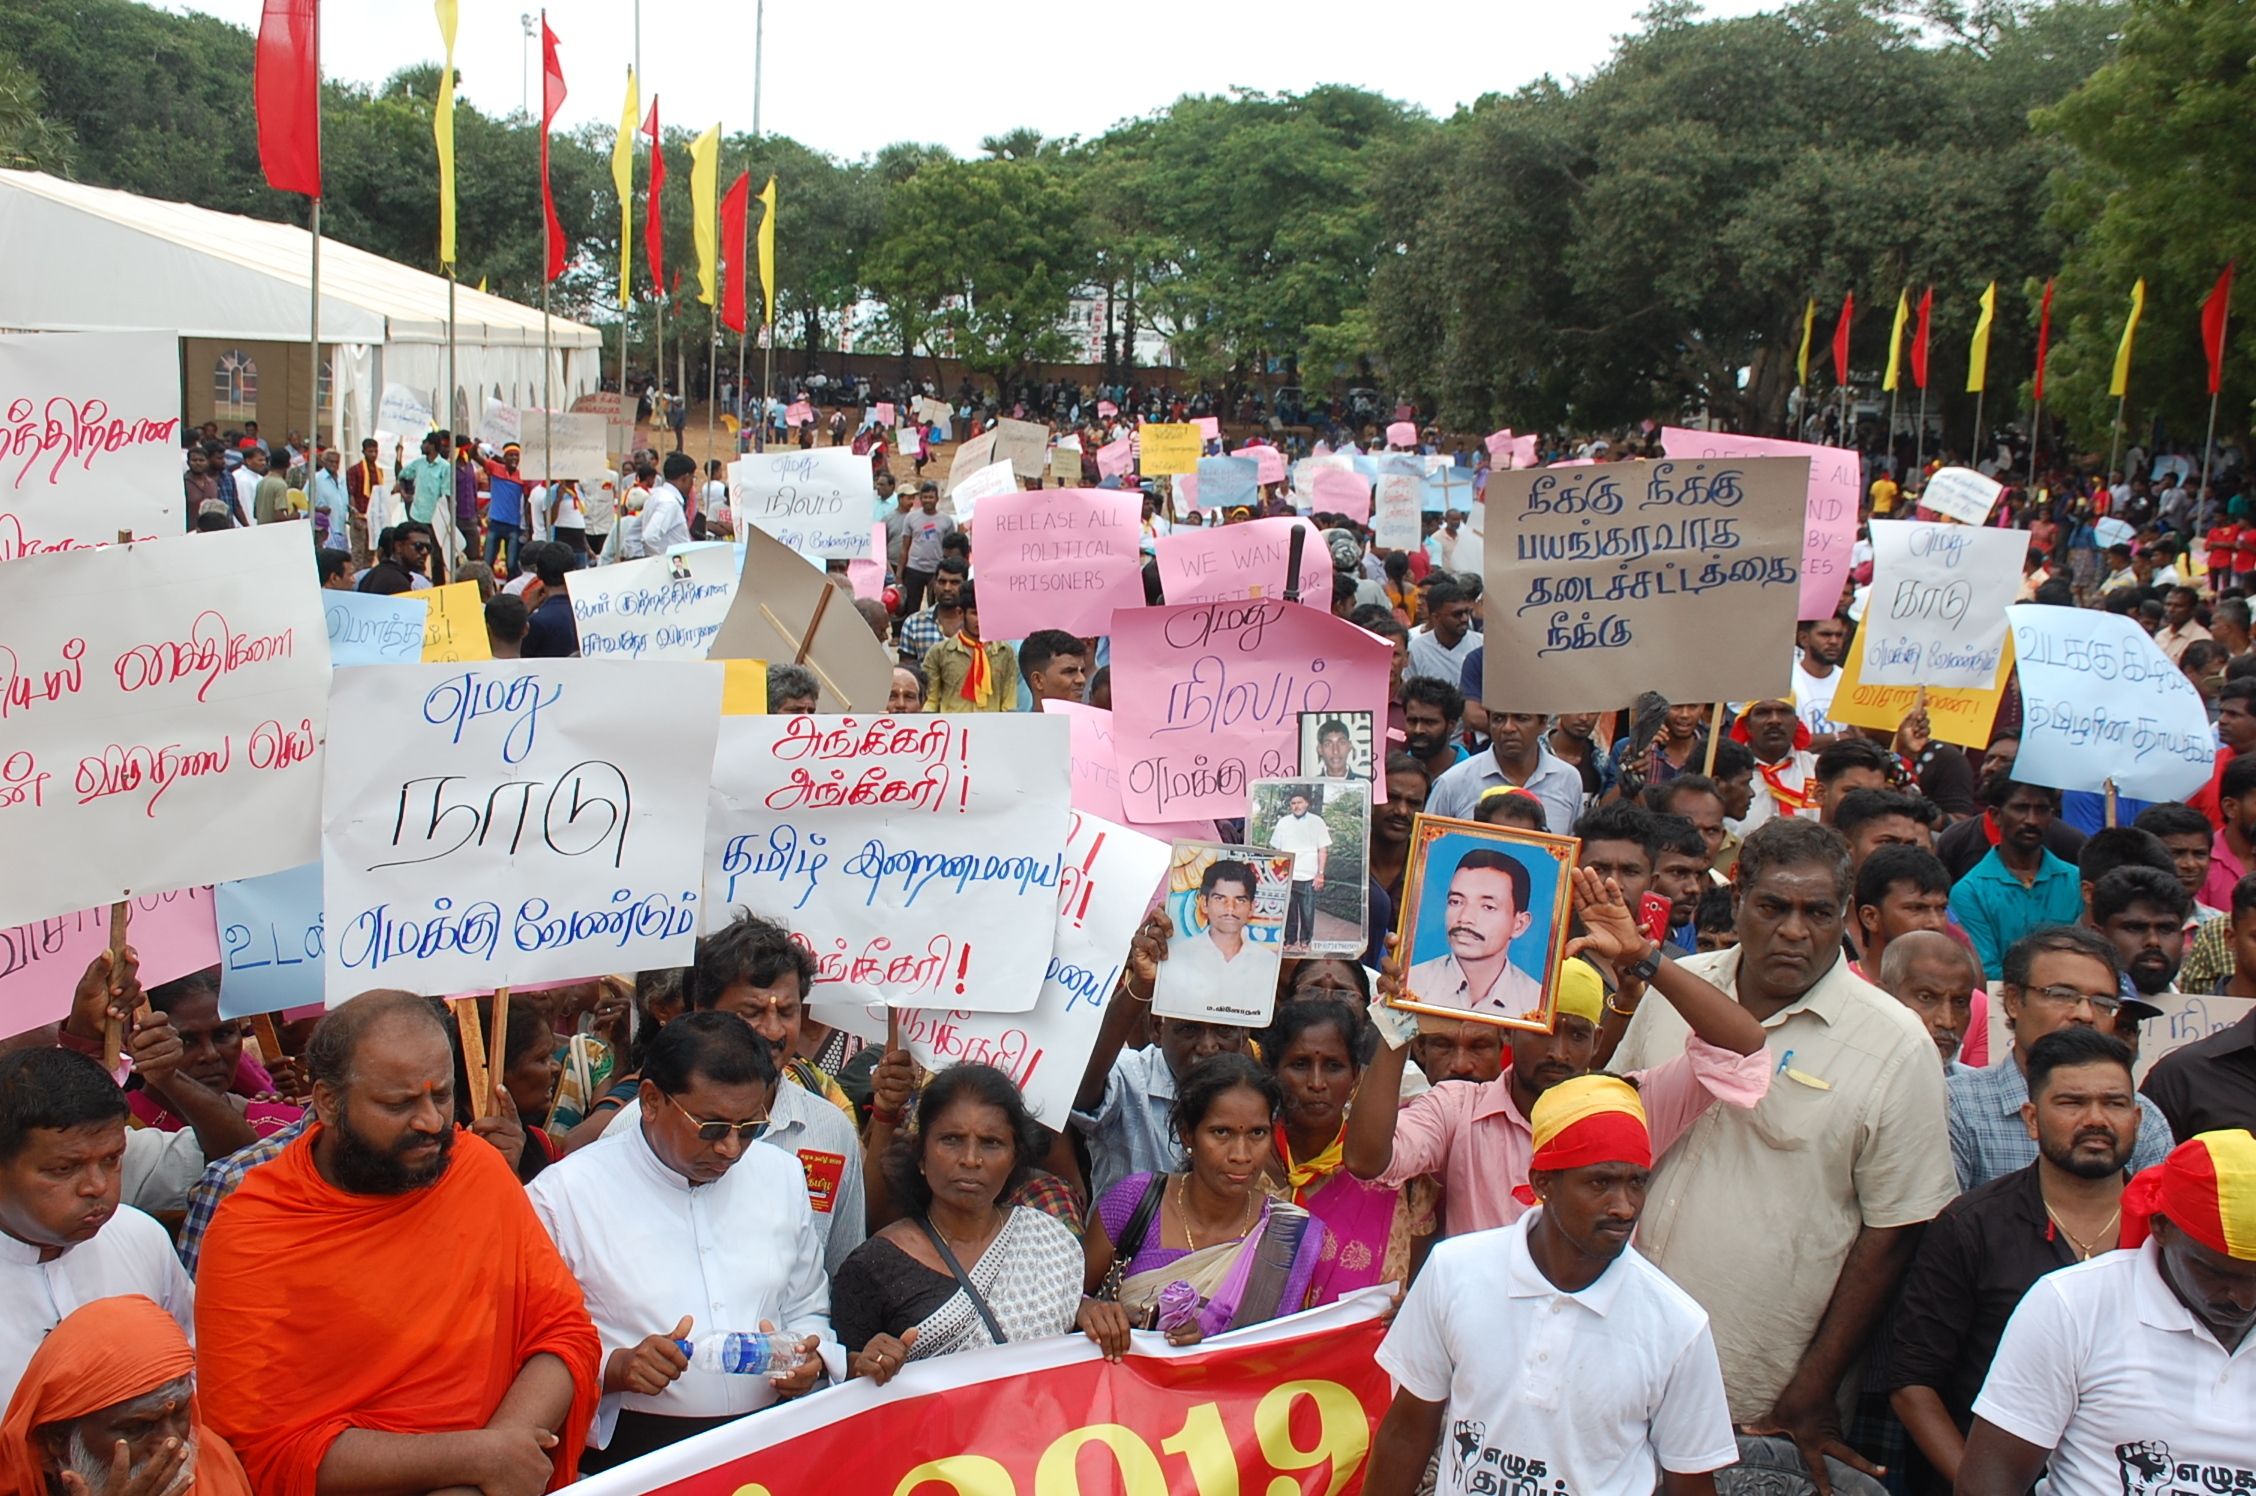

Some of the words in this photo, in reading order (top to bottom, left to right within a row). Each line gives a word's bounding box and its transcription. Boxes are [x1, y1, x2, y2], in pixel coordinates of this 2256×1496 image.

[756, 485, 844, 520] நிலம்
[1518, 474, 1624, 521] நீக்கு
[1639, 463, 1744, 509] நீக்கு
[1808, 499, 1842, 520] ND
[996, 511, 1079, 532] RELEASE
[1087, 508, 1123, 528] ALL
[1518, 517, 1741, 562] பயங்கரவாத
[1021, 540, 1115, 562] POLITICAL
[1180, 551, 1218, 577] WE
[1009, 570, 1105, 592] PRISONERS
[1165, 602, 1286, 652] எமது
[1537, 611, 1632, 659] நீக்கு
[424, 672, 563, 764] எமது
[1150, 655, 1332, 739] நிலம்
[771, 716, 970, 770] அங்கீகரி!
[765, 763, 971, 813] அங்கீகரி!
[1129, 754, 1247, 815] எமக்கு
[366, 760, 631, 872] நாடு
[723, 824, 829, 910] தமிழ்
[340, 897, 502, 970] எமக்கு
[515, 889, 697, 952] வேண்டும்
[1483, 1447, 1548, 1479] எழுக
